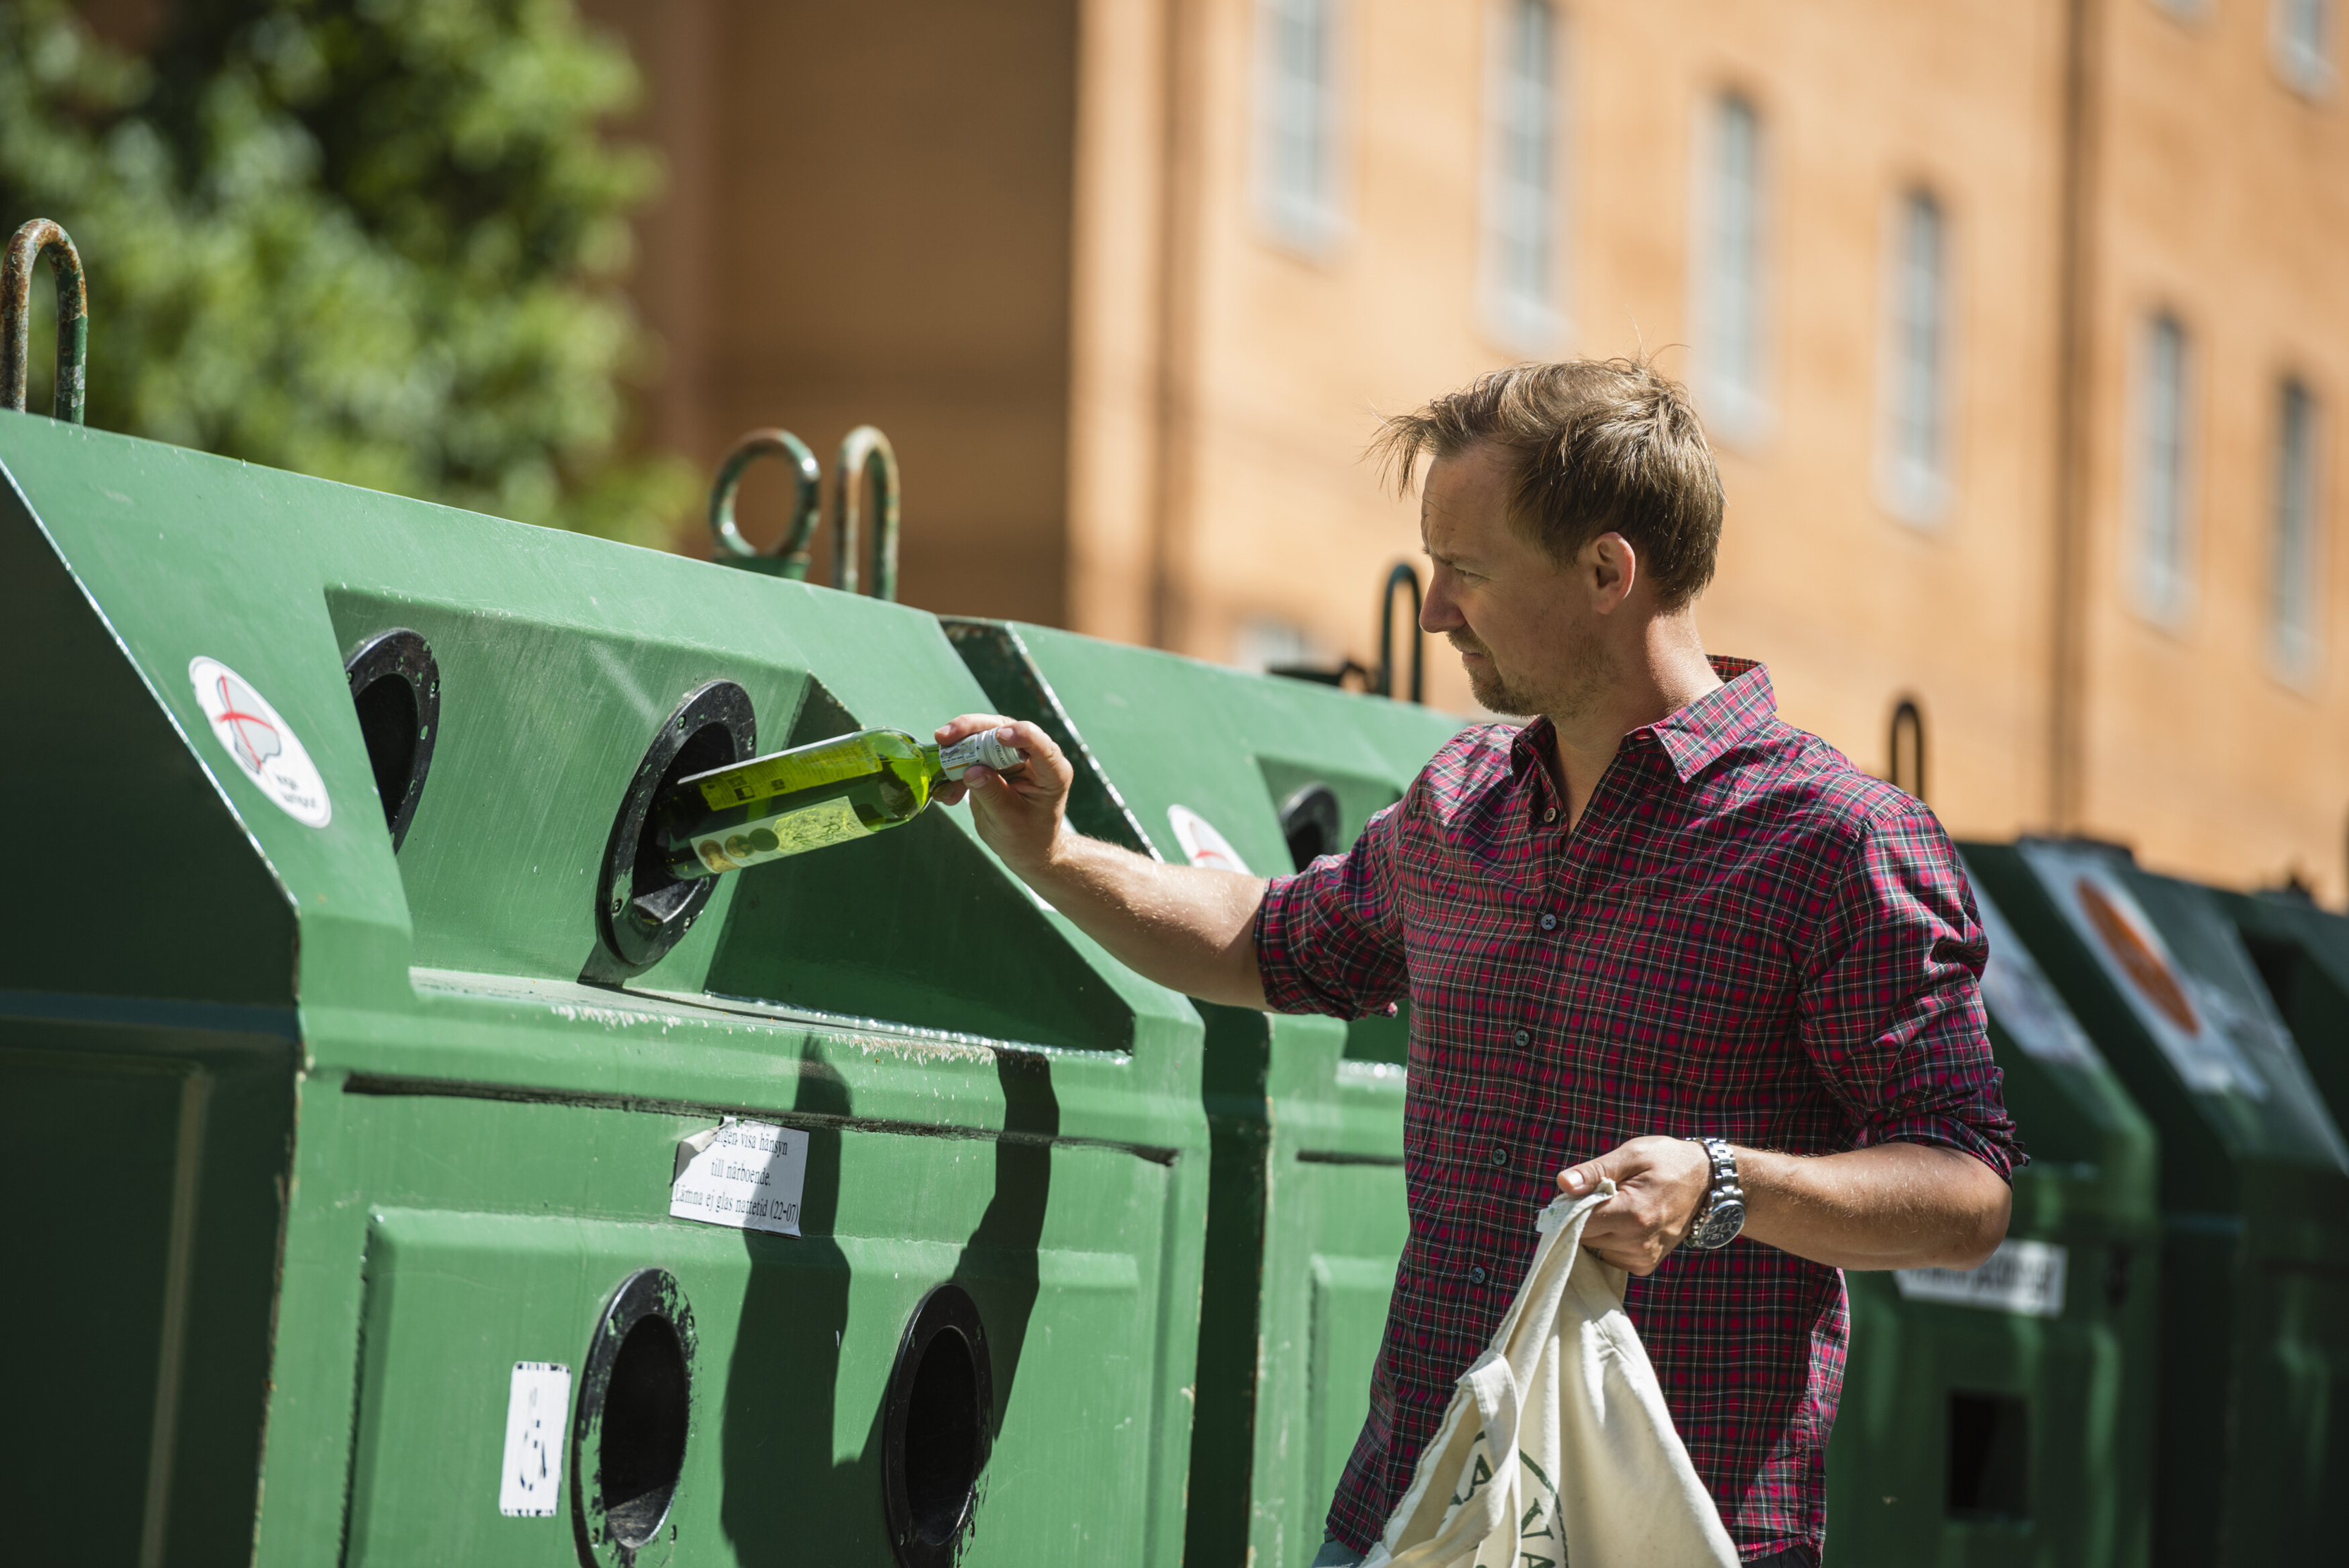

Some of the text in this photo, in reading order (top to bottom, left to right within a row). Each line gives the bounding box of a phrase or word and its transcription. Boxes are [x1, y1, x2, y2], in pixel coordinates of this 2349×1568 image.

[741, 1130, 756, 1149] visa
[759, 1132, 789, 1158] hänsyn
[711, 1158, 771, 1186] till närboende.
[674, 1183, 799, 1225] Lämna ej glas nattetid (22-07)
